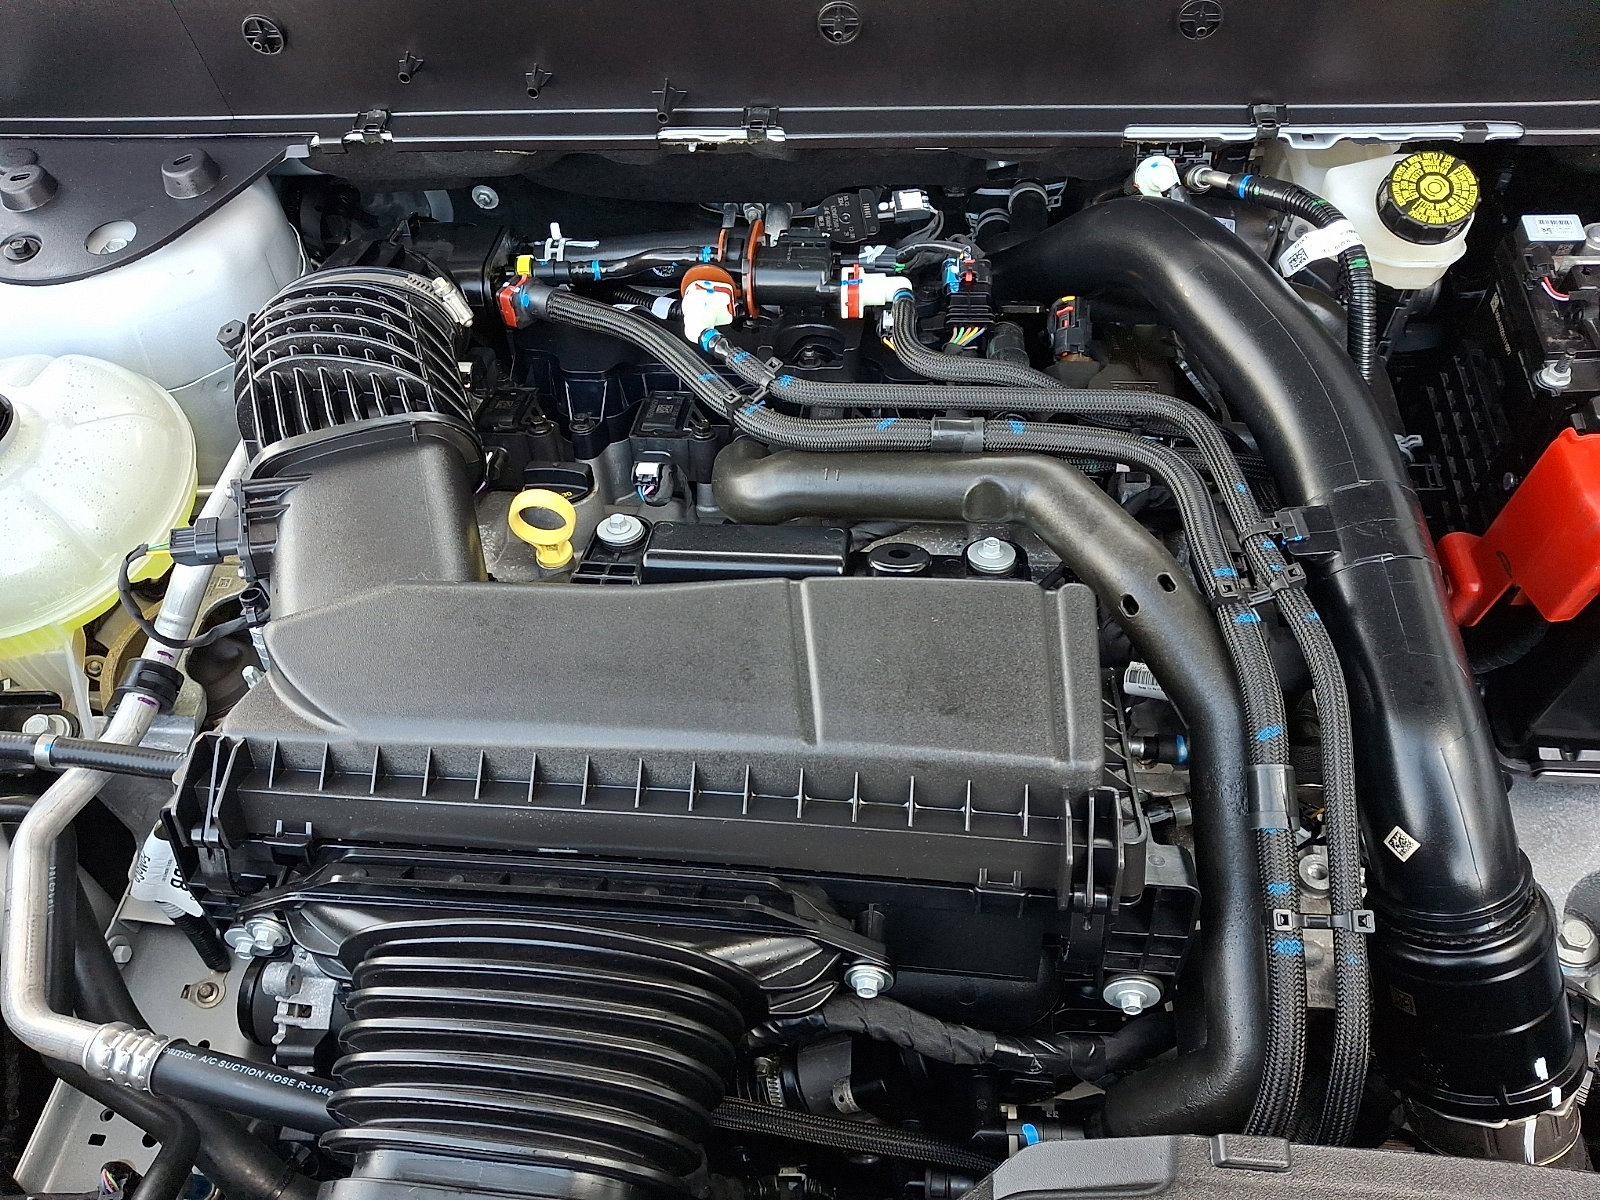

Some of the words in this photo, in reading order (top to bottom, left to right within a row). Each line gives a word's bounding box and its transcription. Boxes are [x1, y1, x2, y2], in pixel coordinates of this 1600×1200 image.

[199, 1055, 218, 1065] A/C
[218, 1060, 265, 1077] SUCTION
[265, 1072, 297, 1087] HOSE
